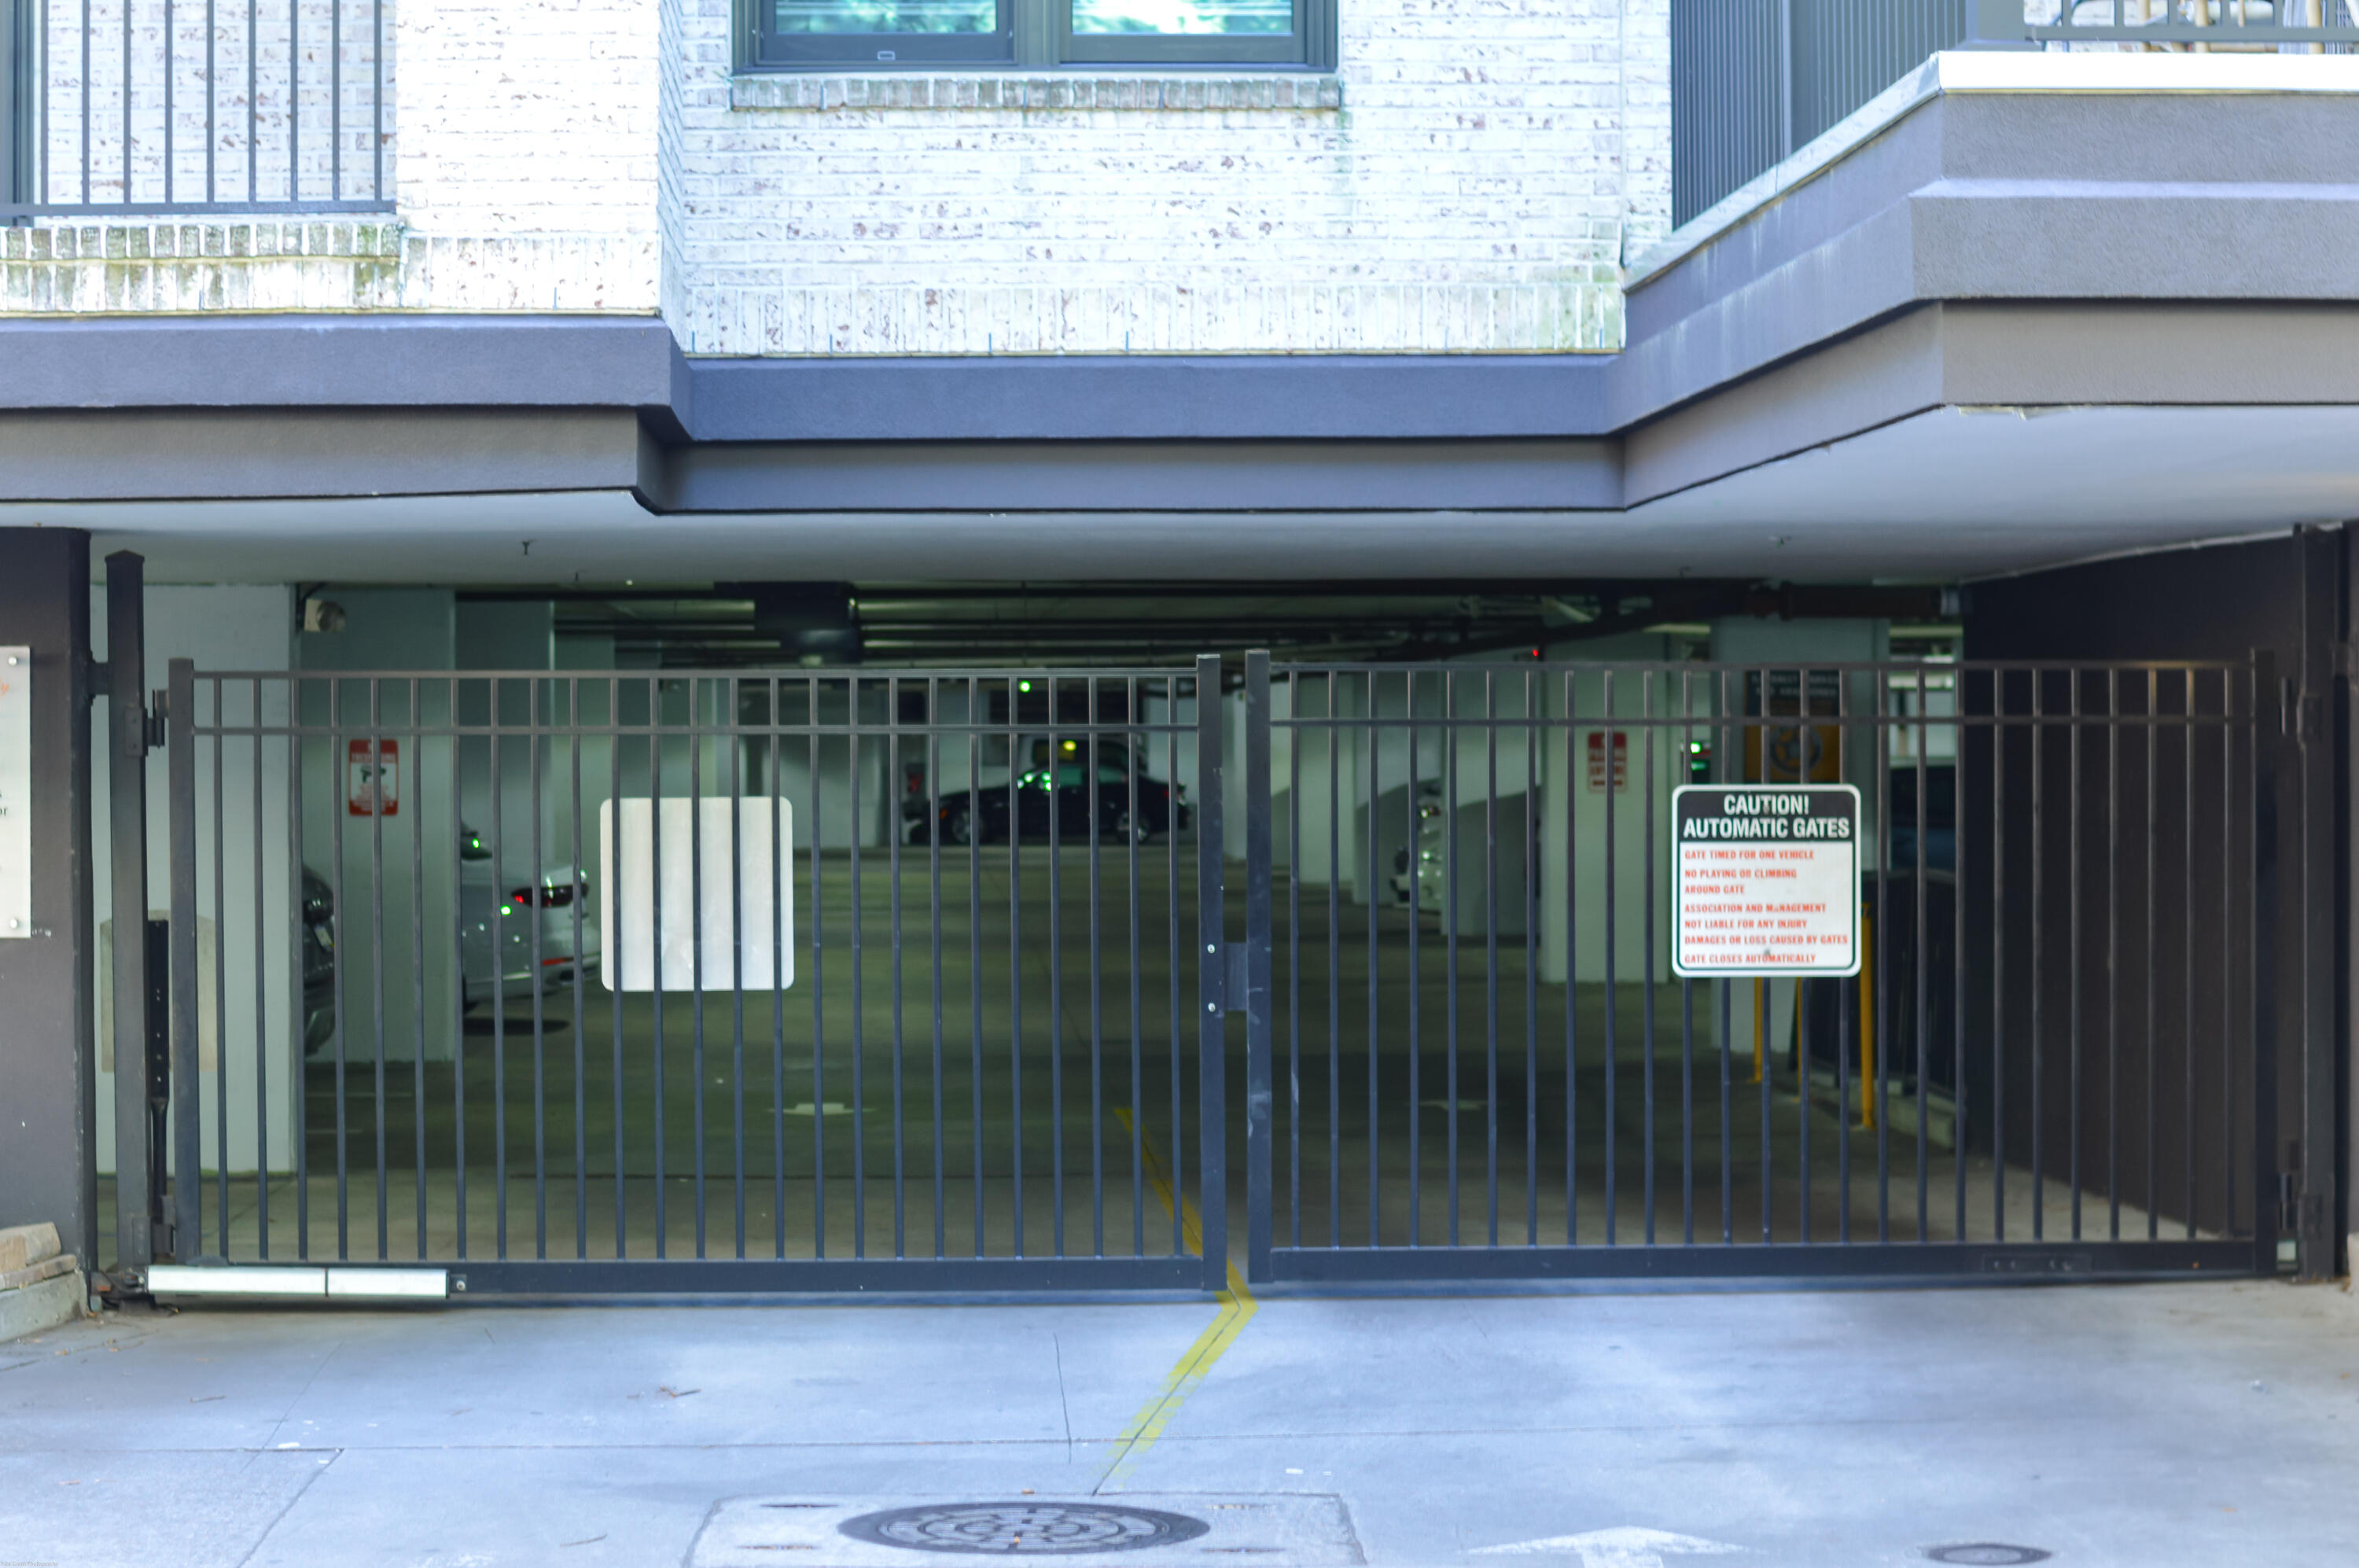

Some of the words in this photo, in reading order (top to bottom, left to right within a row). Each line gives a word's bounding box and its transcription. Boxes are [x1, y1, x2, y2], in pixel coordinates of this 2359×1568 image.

[1724, 794, 1809, 815] CAUTION!
[1684, 818, 1788, 838] AUTOMATIC
[1793, 818, 1849, 838] GATES
[1684, 850, 1706, 859] GATE
[1709, 850, 1736, 859] TIMED
[1739, 850, 1756, 859] FOR
[1758, 850, 1776, 859] ONE
[1779, 850, 1814, 859] VEHICLE
[1684, 869, 1697, 878] NO
[1699, 869, 1736, 878] PLAYING
[1739, 869, 1751, 878] OR
[1754, 869, 1797, 878] CLIMBING
[1684, 885, 1720, 894] AROUND
[1723, 885, 1745, 894] GATE
[1684, 904, 1743, 913] ASSOCIATION
[1745, 904, 1763, 913] AND
[1684, 919, 1702, 929] NOT
[1705, 919, 1734, 929] LIABLE
[1737, 919, 1754, 929] FOR
[1757, 919, 1774, 929] ANY
[1777, 919, 1807, 929] INJURY
[1684, 935, 1726, 944] DAMAGES
[1729, 935, 1741, 944] OR
[1743, 935, 1766, 944] LOSS
[1769, 935, 1803, 944] CAUSED
[1806, 935, 1817, 944] BY
[1820, 935, 1848, 944] GATES
[1684, 954, 1706, 963] GATE
[1709, 954, 1743, 963] CLOSES
[1745, 954, 1816, 963] AUTOMATICALLY
